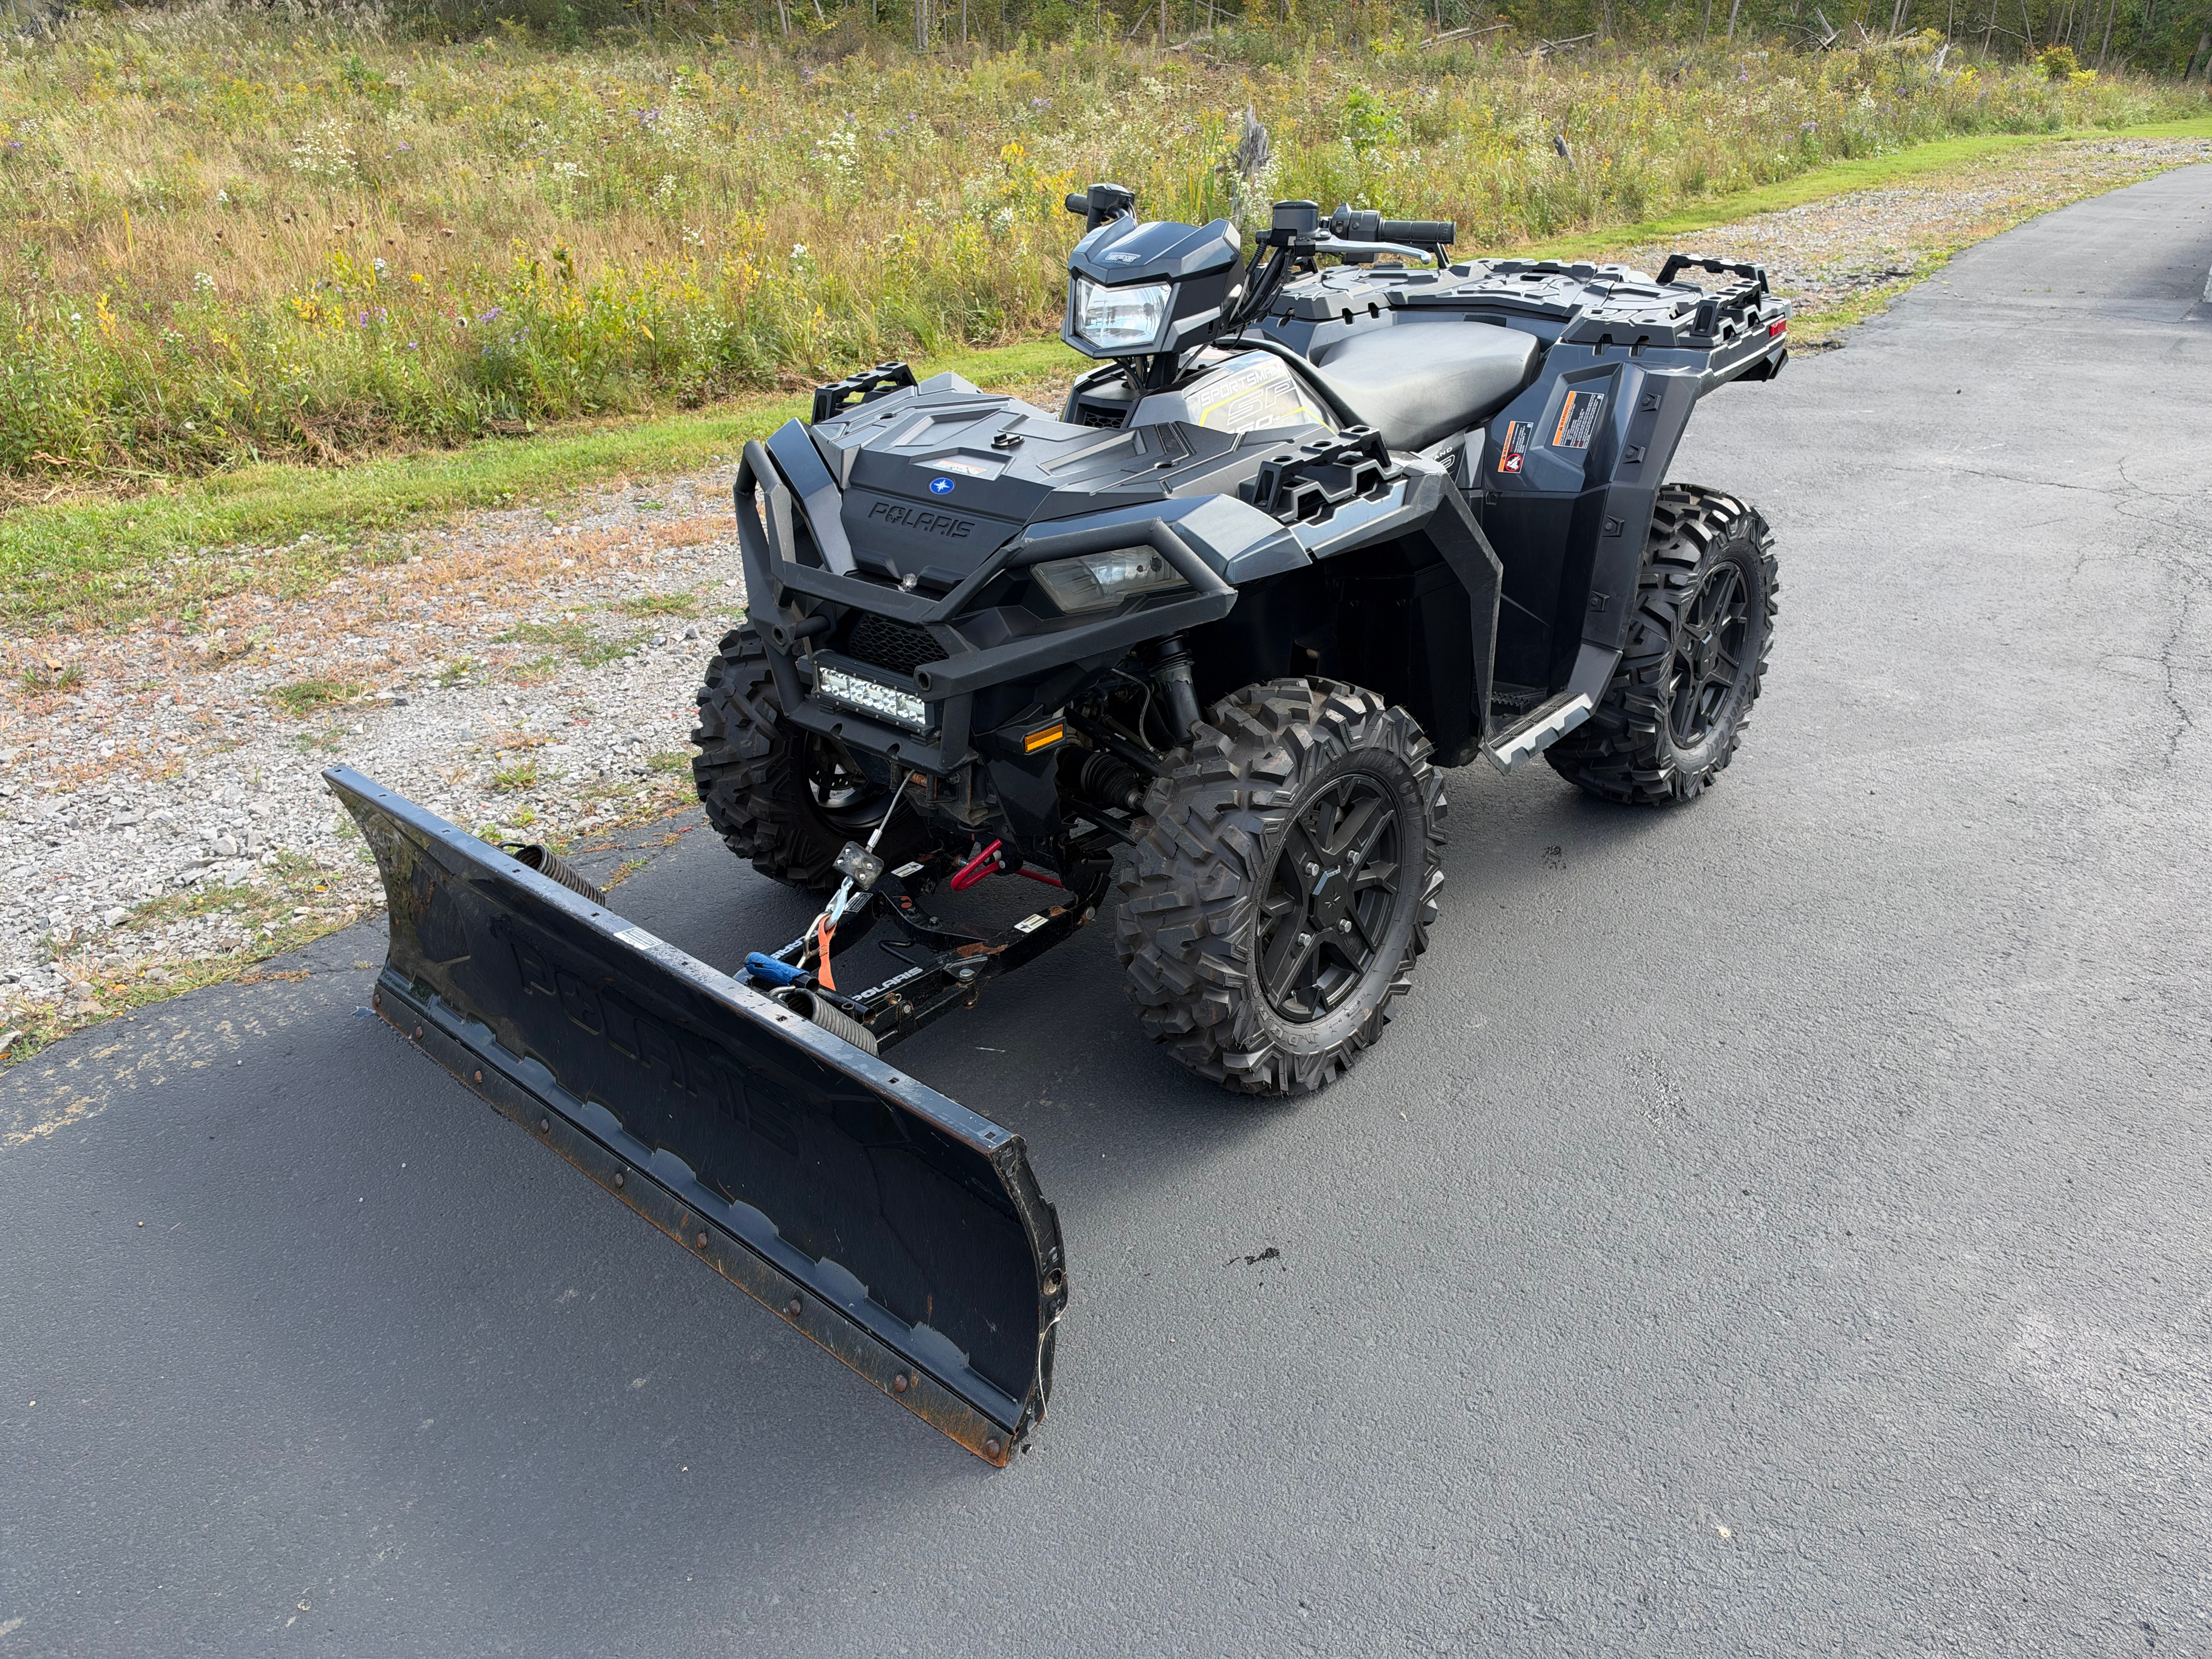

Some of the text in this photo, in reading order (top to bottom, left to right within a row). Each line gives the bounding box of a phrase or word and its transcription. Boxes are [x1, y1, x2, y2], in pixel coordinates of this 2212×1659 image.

[1105, 254, 1137, 263] EPS
[1201, 363, 1283, 407] SPORTSMAN
[1227, 377, 1297, 426] SP
[1560, 405, 1570, 426] WARNING
[1226, 414, 1273, 434] 50
[1503, 434, 1511, 455] WARNING
[868, 502, 975, 538] POLARIS
[1398, 781, 1422, 829] GRIP
[1176, 867, 1199, 879] DURO
[509, 942, 800, 1158] POLARIS
